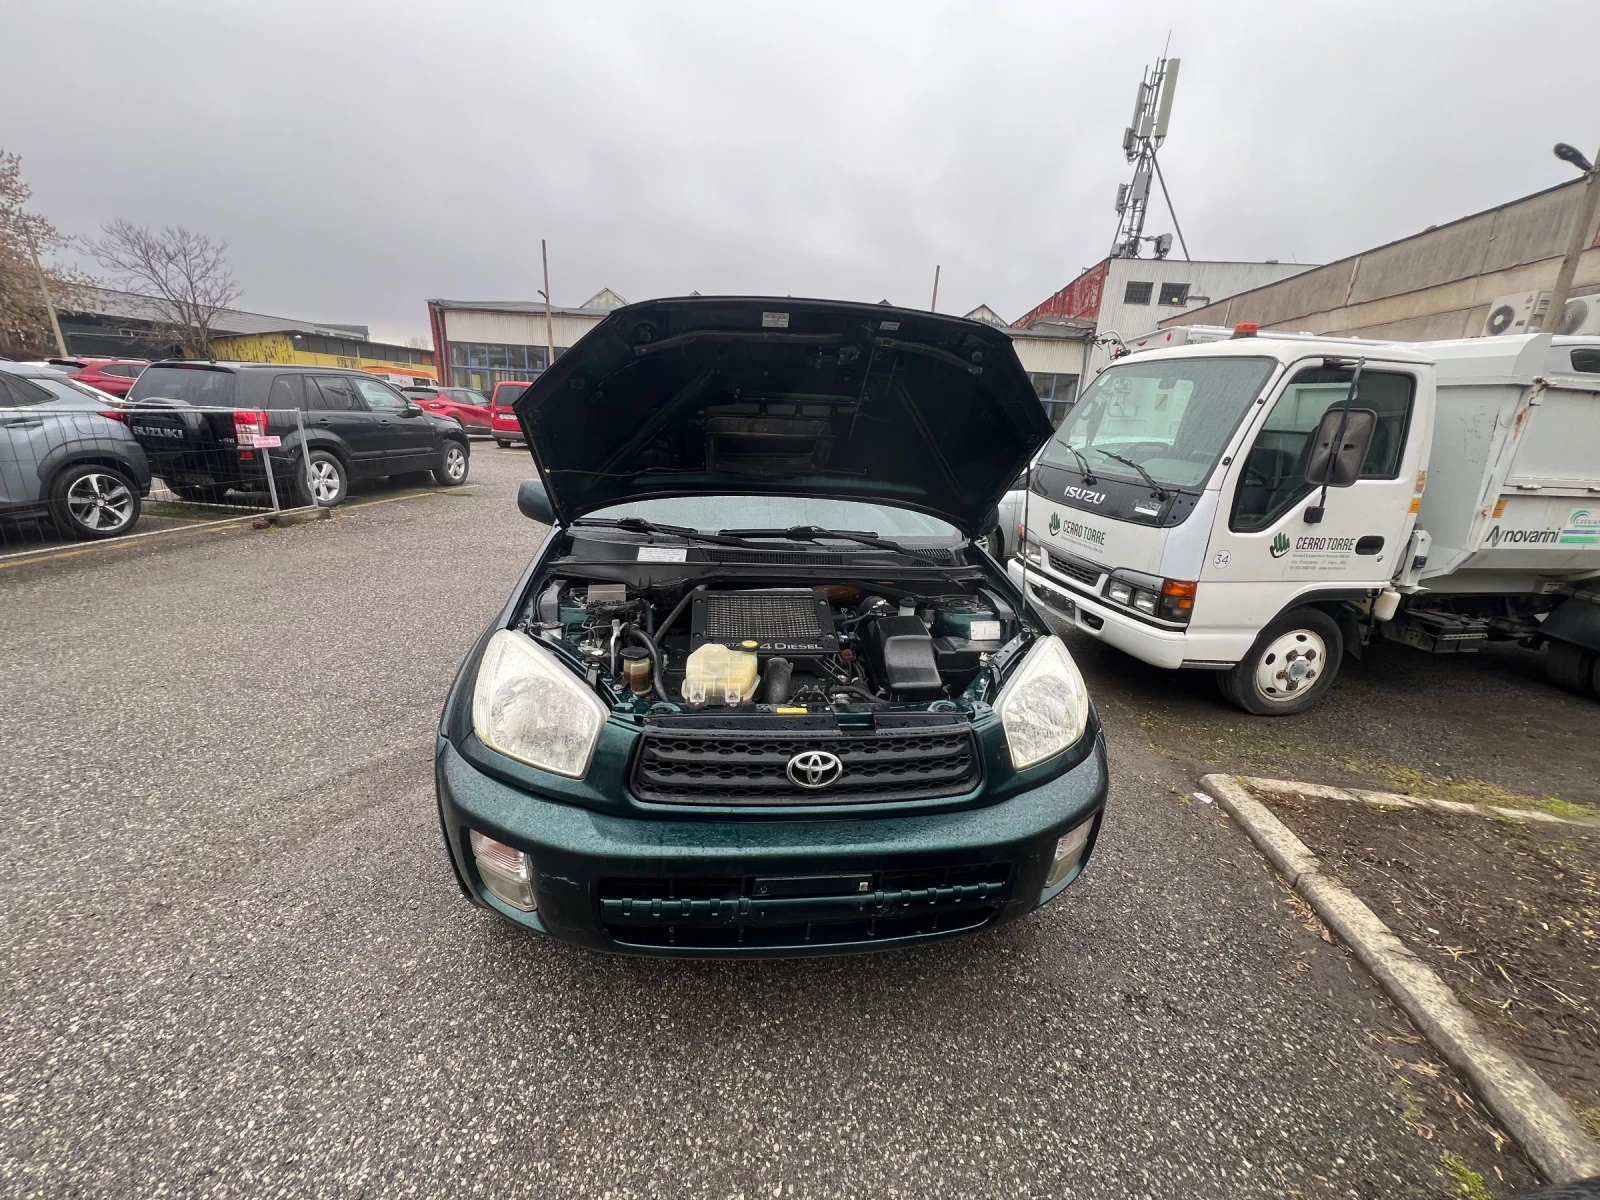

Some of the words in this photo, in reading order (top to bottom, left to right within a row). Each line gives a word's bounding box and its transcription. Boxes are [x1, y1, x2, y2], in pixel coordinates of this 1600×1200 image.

[133, 426, 183, 439] SUZUKI
[1063, 485, 1106, 505] ISUZU
[1062, 520, 1083, 538] CERRO
[1083, 526, 1106, 546] TORRE
[1503, 527, 1561, 543] novarini
[1296, 537, 1326, 550] CERRO
[1326, 538, 1356, 551] TORRE
[1215, 554, 1229, 565] 34
[774, 642, 823, 650] DIESEL
